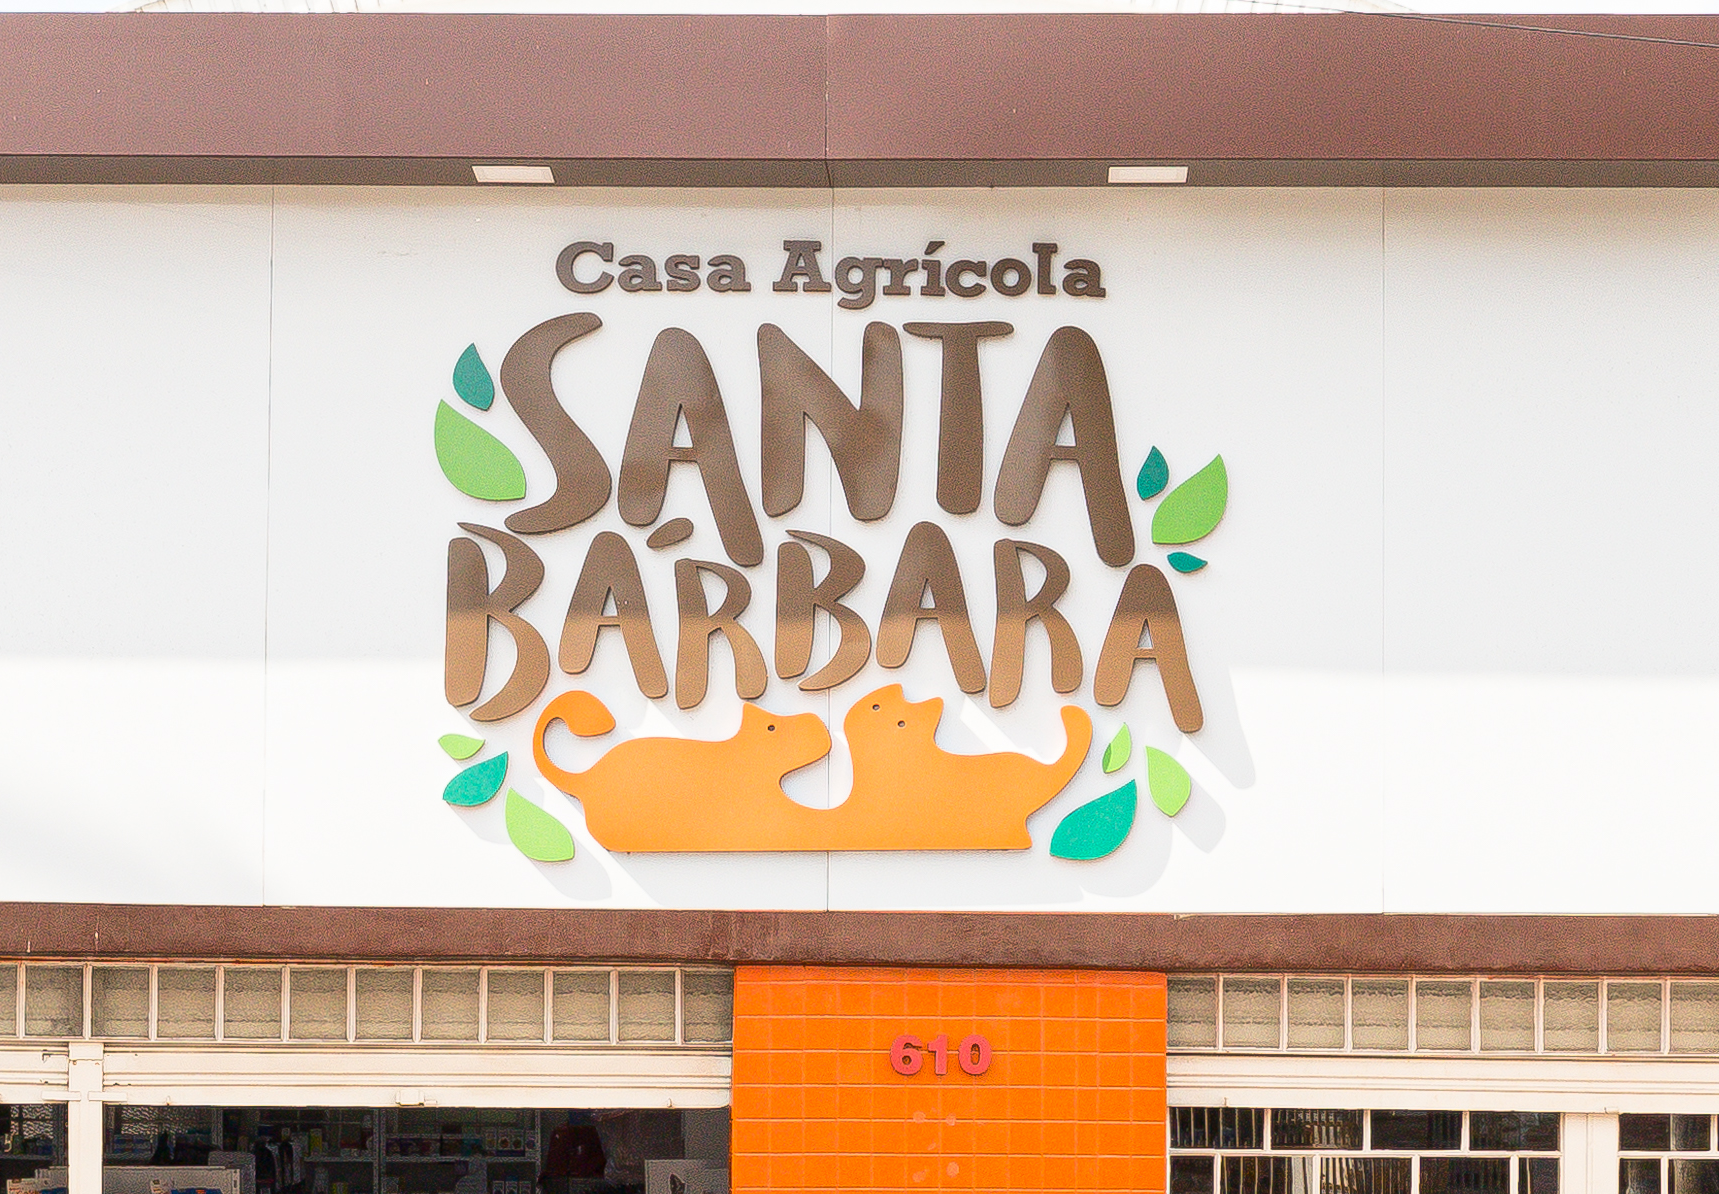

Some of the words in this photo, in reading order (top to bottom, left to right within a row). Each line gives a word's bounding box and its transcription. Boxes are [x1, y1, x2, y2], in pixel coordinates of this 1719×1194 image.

[555, 241, 752, 294] Casa
[772, 240, 1107, 309] Agrícola
[499, 311, 1136, 568] SANTA
[444, 517, 1204, 733] BÁRBARA
[889, 1034, 993, 1076] 610
